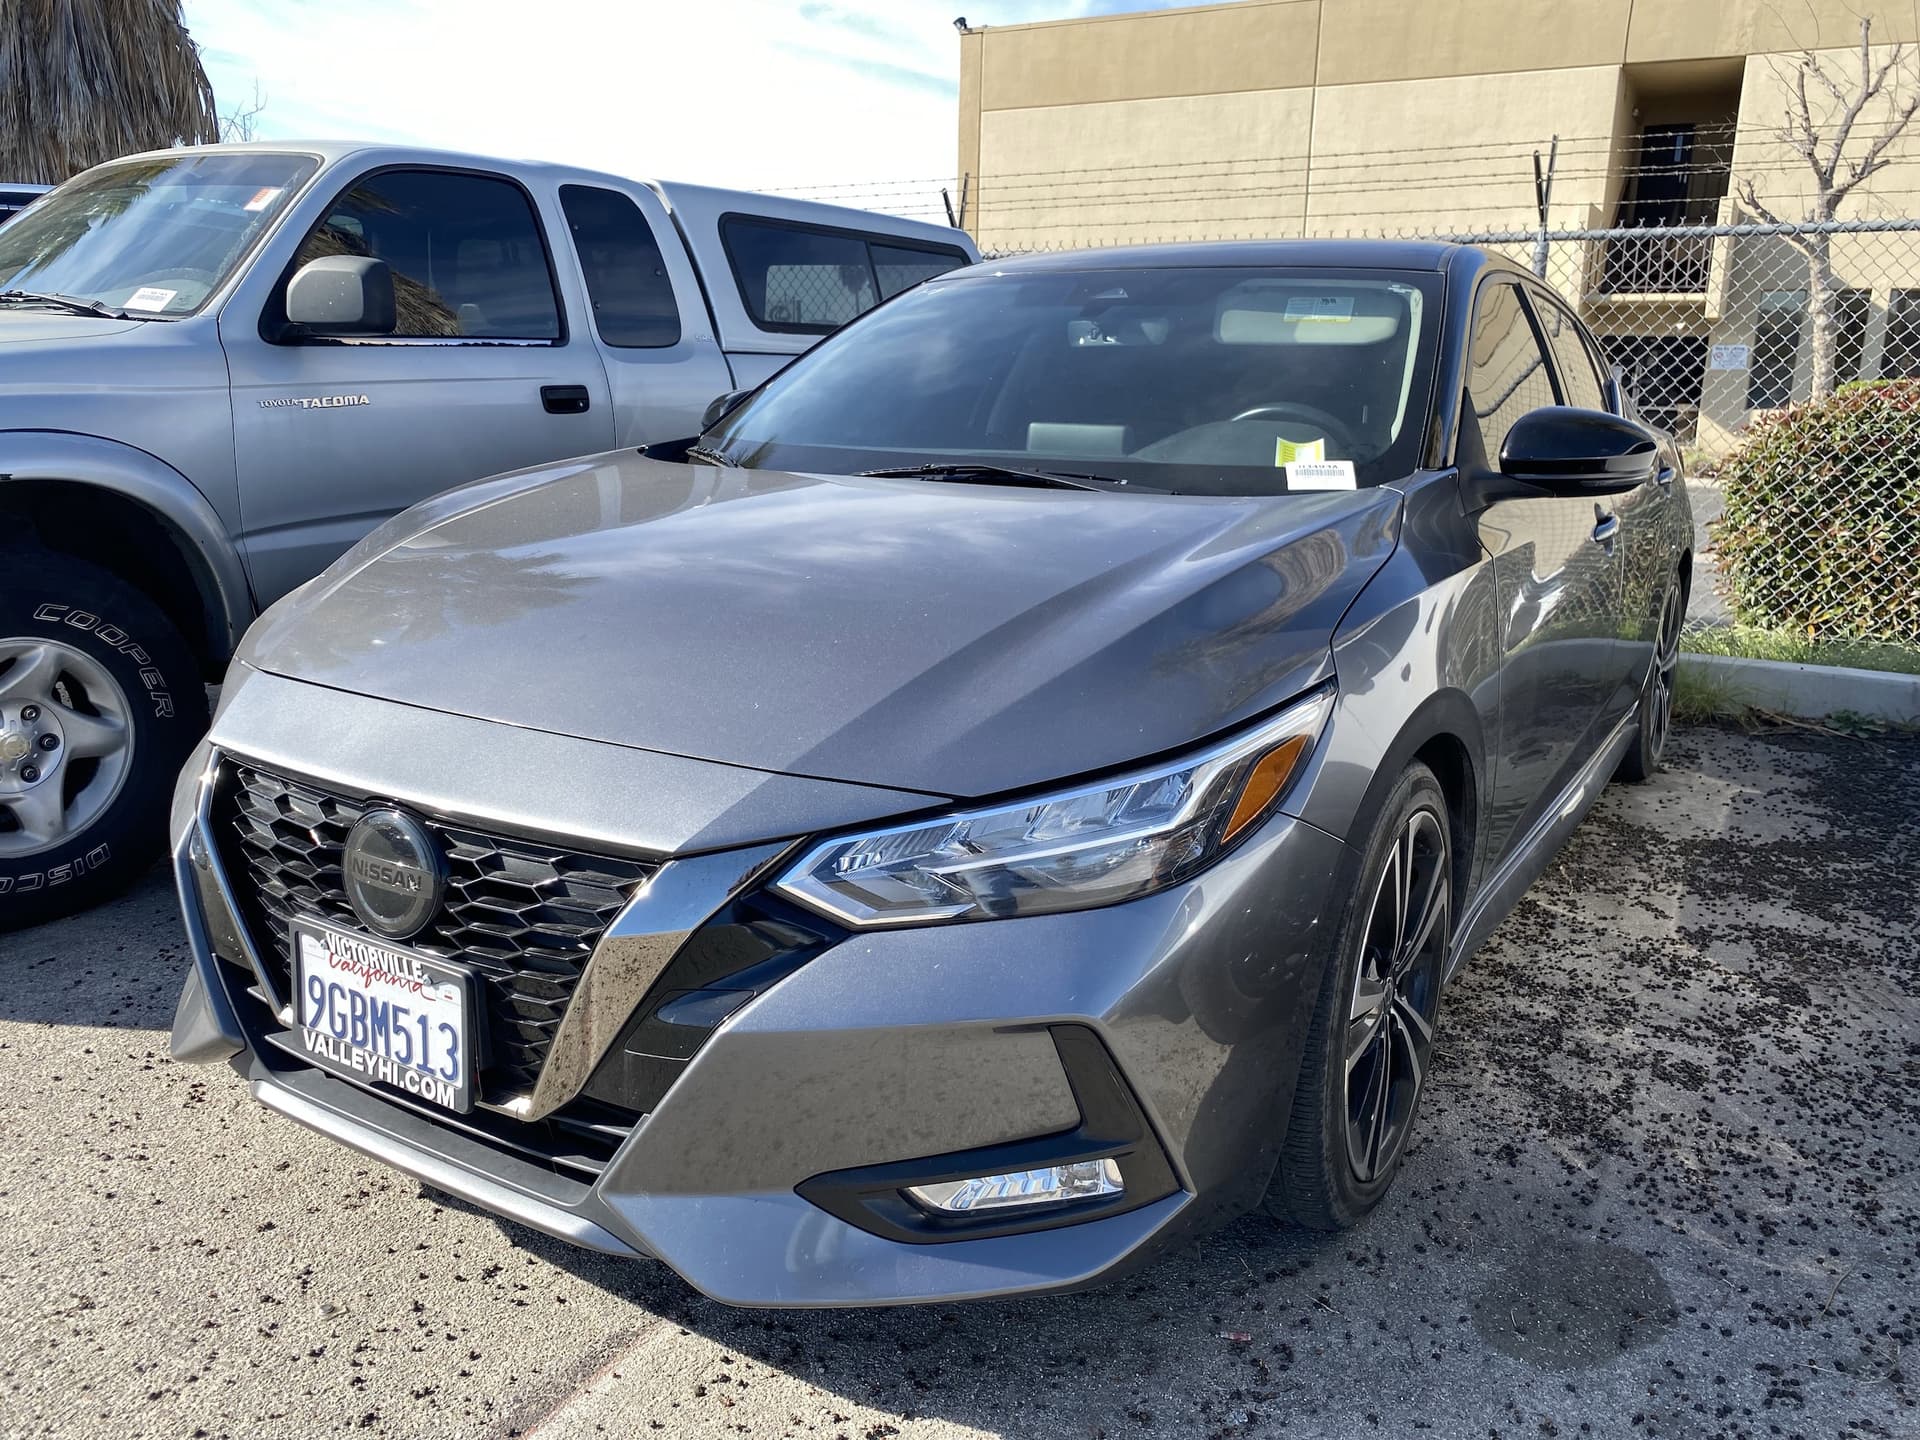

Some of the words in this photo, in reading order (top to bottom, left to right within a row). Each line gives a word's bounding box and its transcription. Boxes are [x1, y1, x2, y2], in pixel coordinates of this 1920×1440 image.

[300, 394, 370, 409] TACOMA
[33, 603, 175, 718] COOPER
[352, 857, 422, 891] NISSAN
[325, 931, 424, 982] VICTORVILLE
[308, 974, 458, 1081] 9GBM513
[303, 1028, 455, 1110] VALLEYHI.COM
